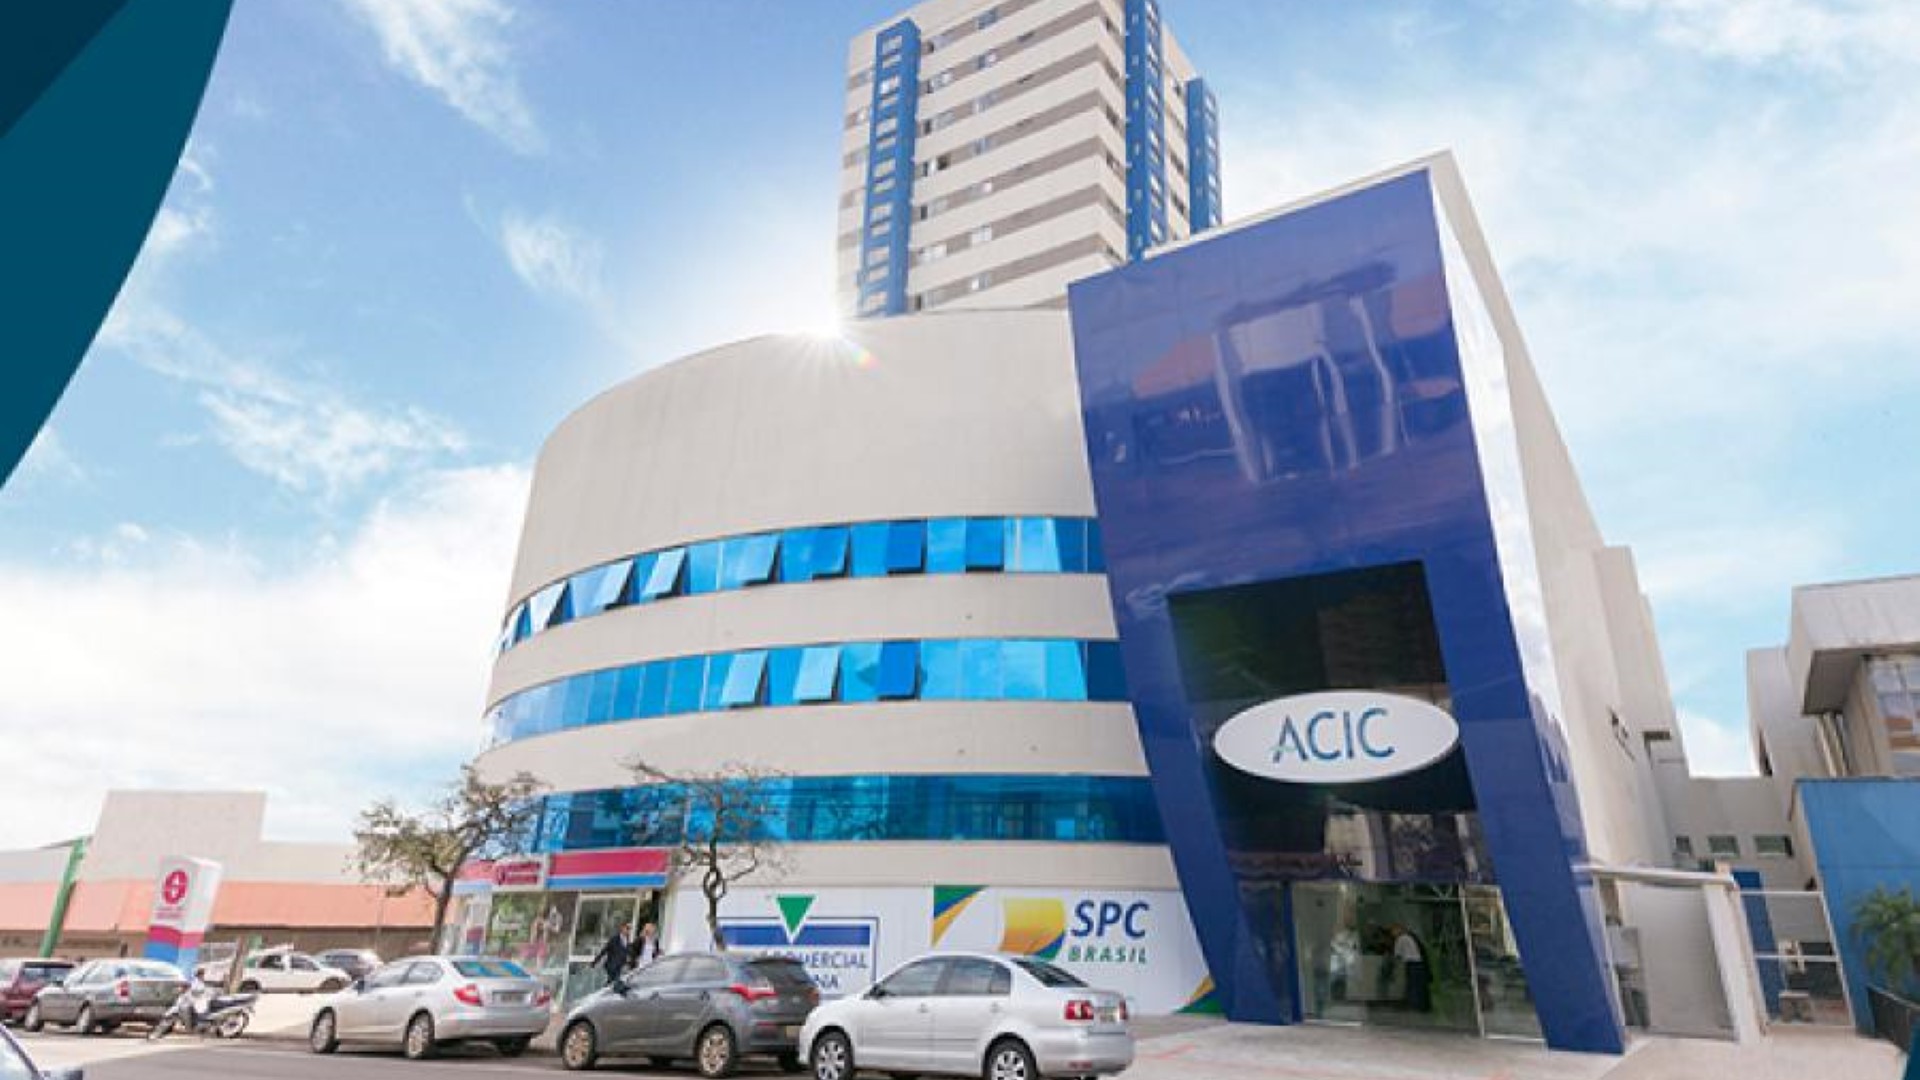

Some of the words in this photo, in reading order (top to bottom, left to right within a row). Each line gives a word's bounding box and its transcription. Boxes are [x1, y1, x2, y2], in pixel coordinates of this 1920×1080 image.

[1270, 707, 1395, 764] ACIC
[1070, 899, 1150, 938] SPC
[1067, 945, 1147, 965] BRASIL
